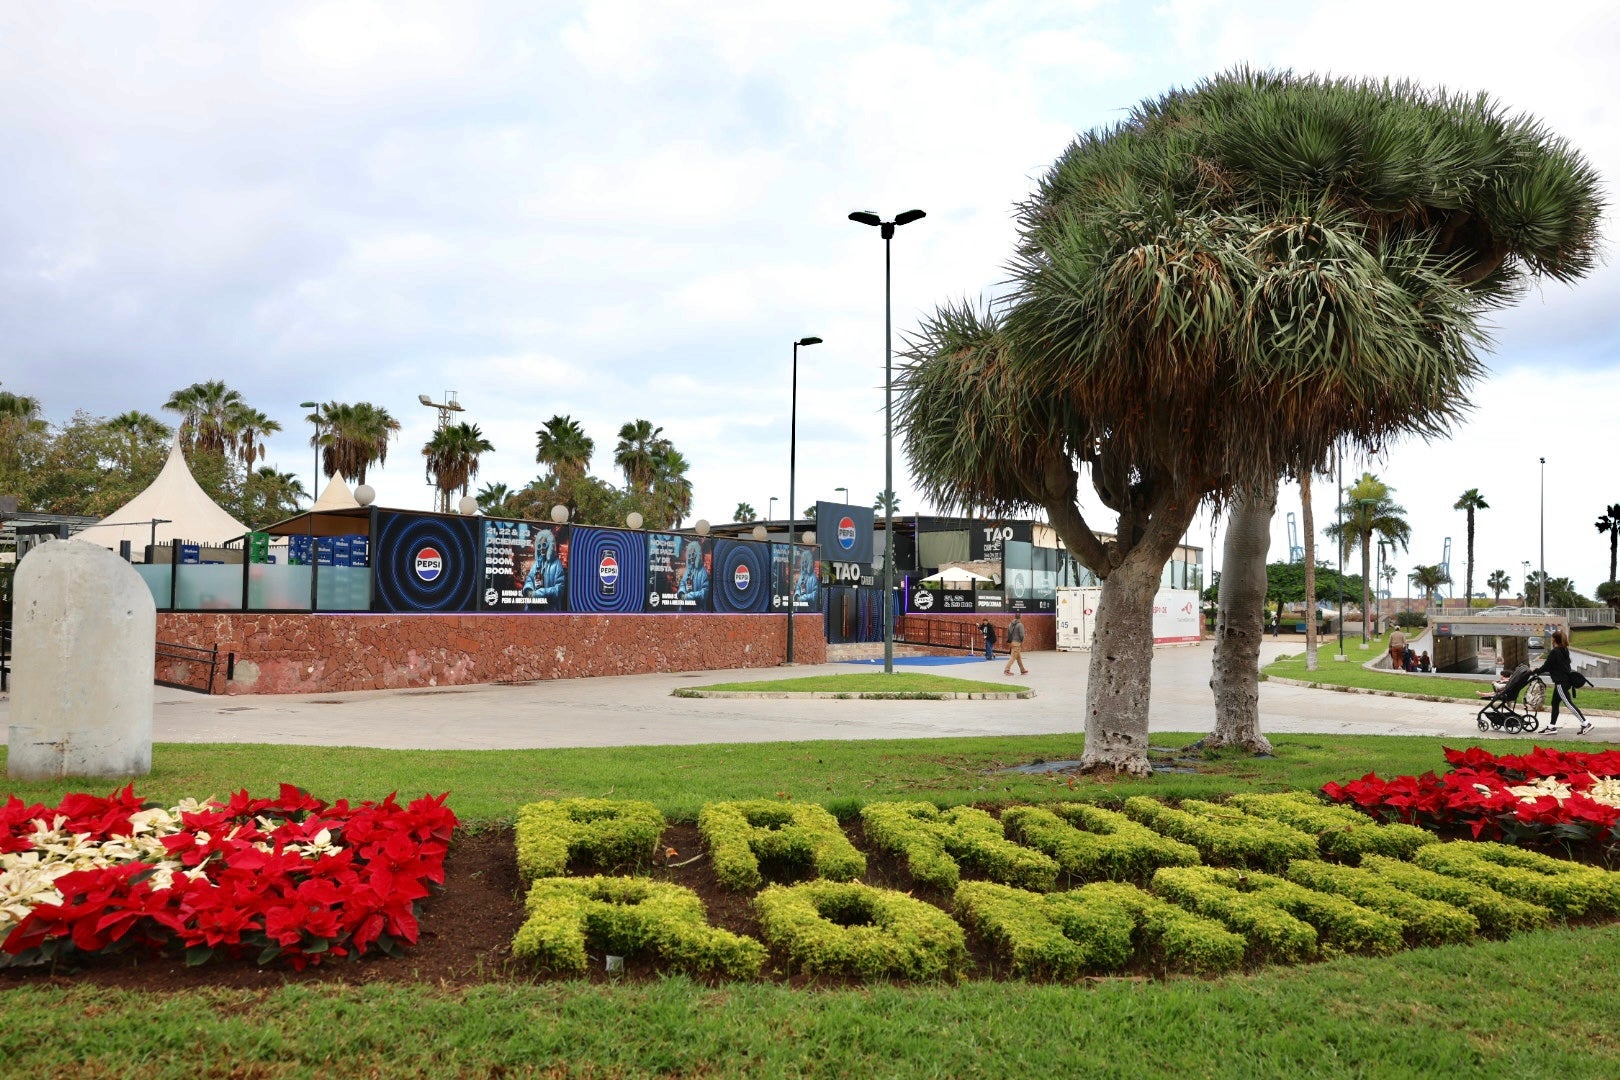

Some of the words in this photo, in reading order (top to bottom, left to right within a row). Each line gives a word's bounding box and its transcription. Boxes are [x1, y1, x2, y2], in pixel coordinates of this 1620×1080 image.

[839, 529, 854, 537] PEPSI
[984, 527, 1013, 541] TAO
[417, 560, 441, 568] PEPSI
[832, 563, 860, 581] TAO
